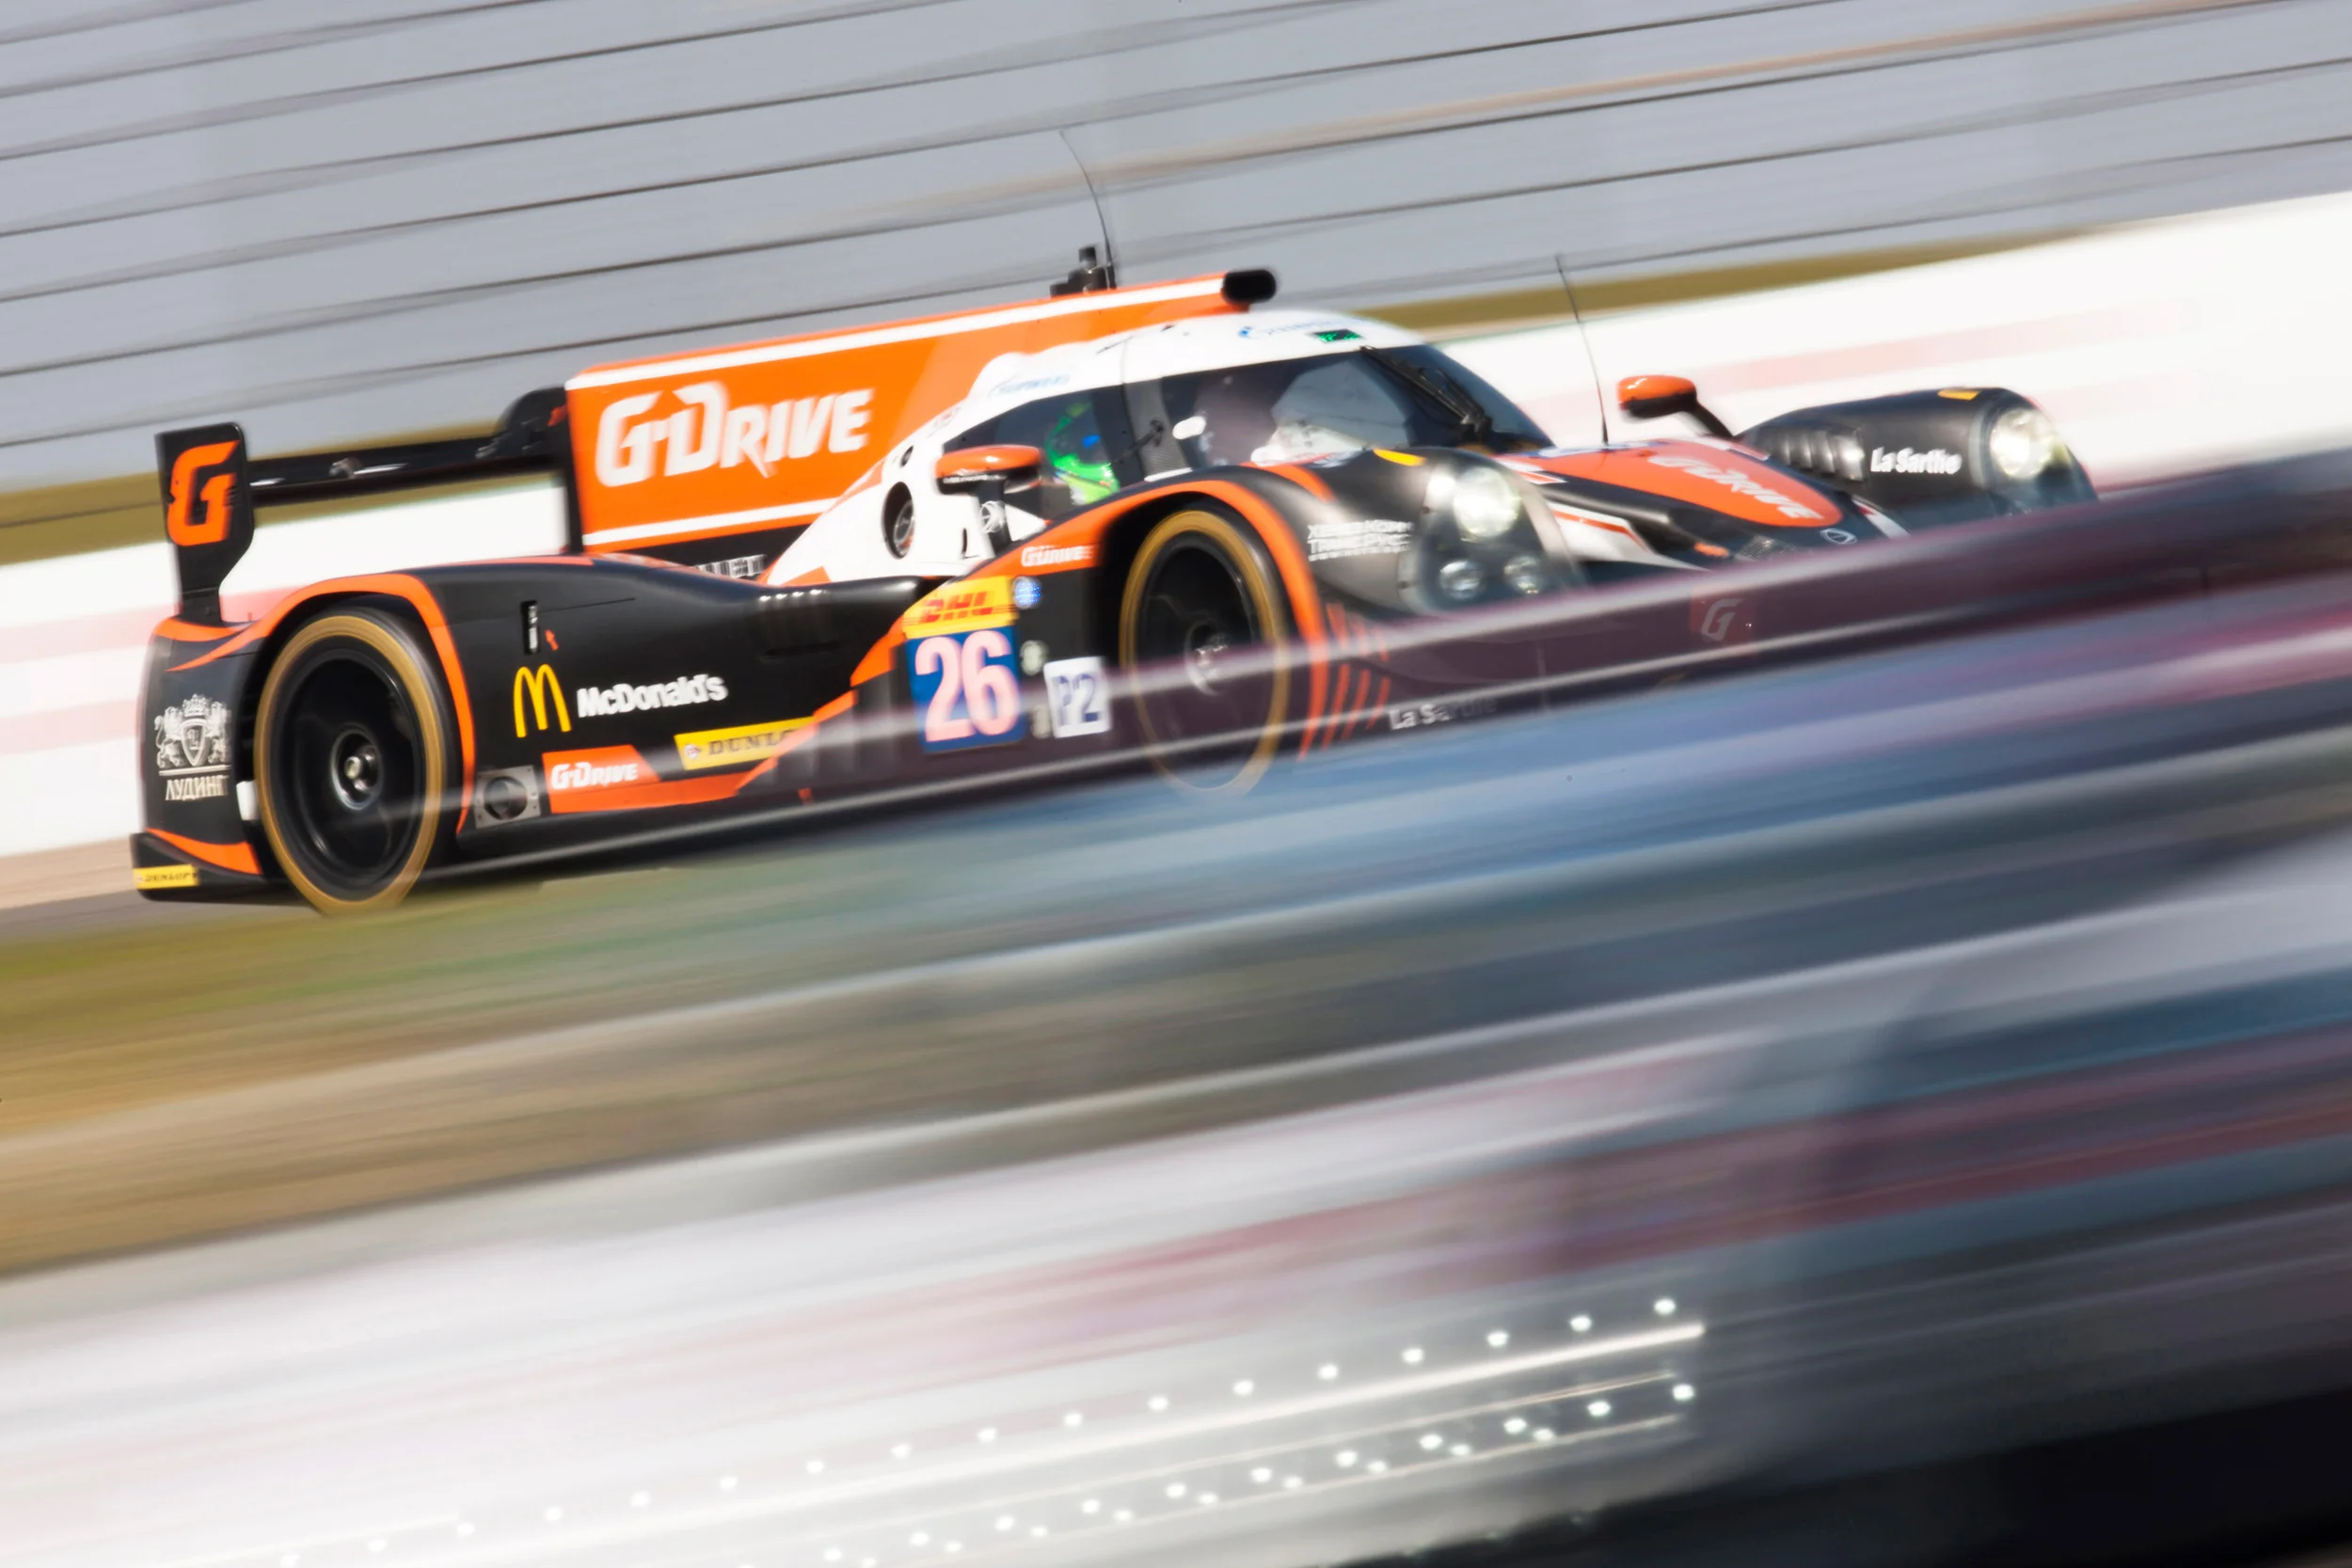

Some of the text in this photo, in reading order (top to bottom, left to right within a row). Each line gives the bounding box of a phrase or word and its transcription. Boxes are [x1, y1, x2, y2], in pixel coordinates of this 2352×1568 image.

[1870, 447, 1963, 474] La Sarthe
[918, 591, 997, 624] DHL
[577, 673, 729, 718] McDonald's
[914, 630, 1020, 742] 26
[1050, 672, 1100, 727] P2
